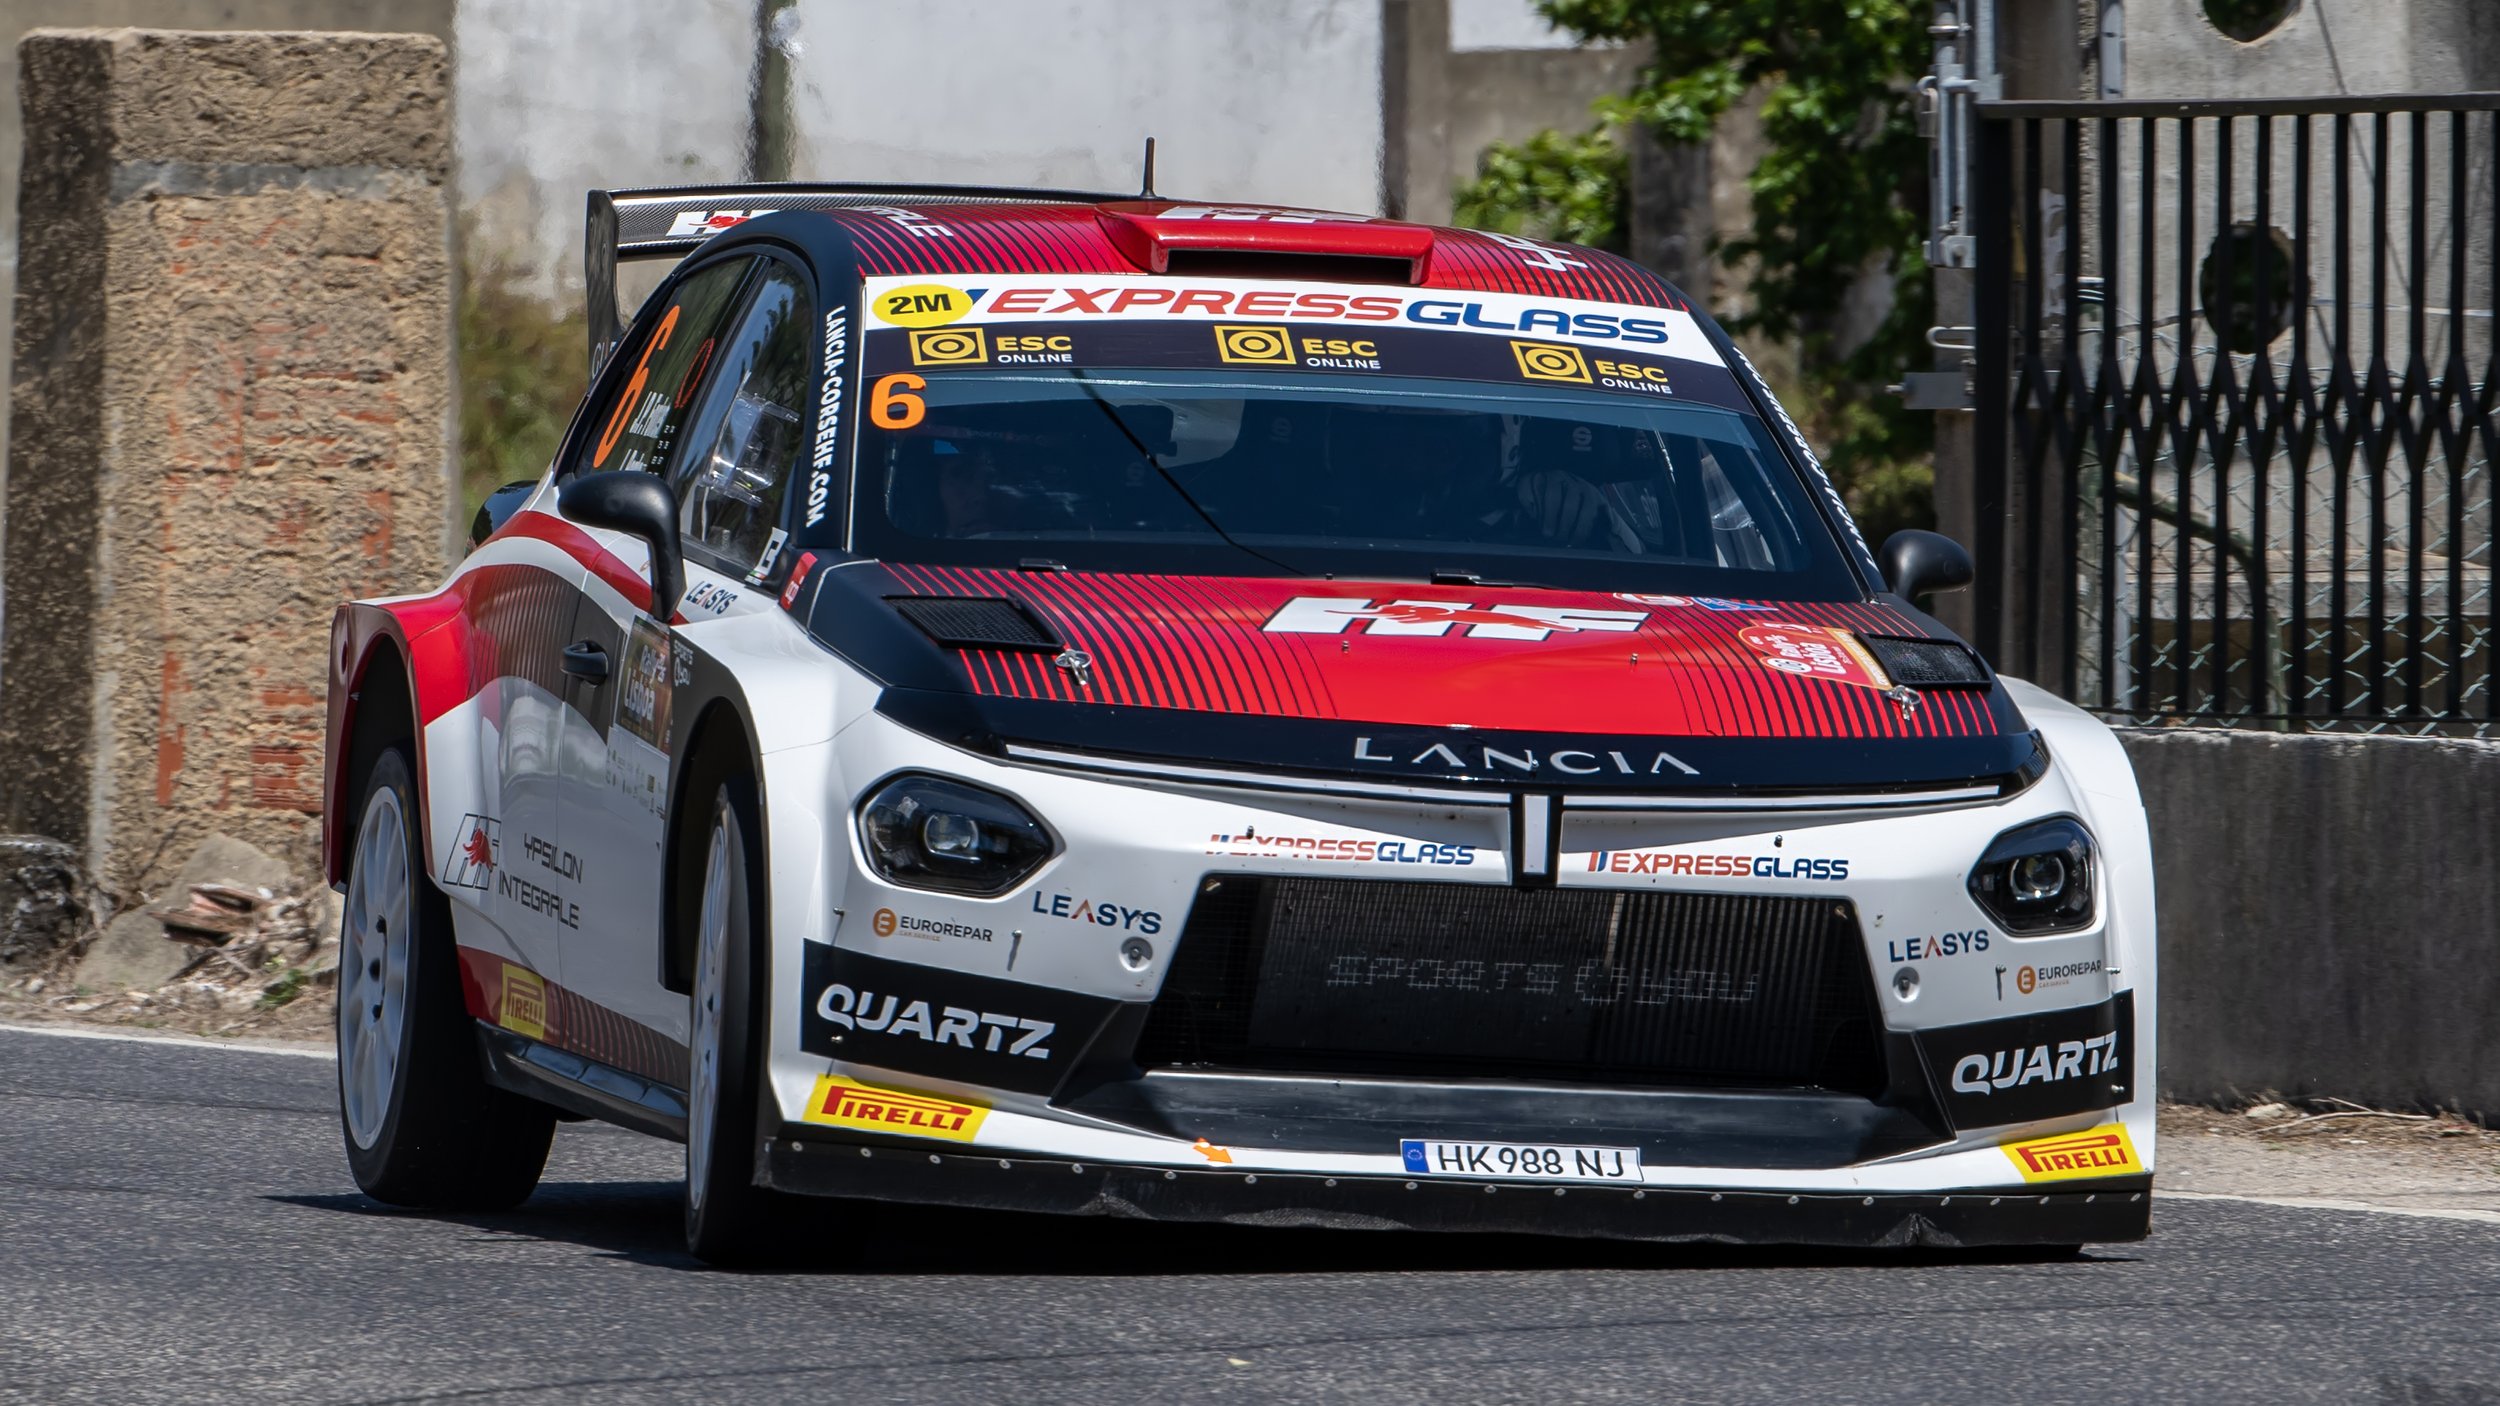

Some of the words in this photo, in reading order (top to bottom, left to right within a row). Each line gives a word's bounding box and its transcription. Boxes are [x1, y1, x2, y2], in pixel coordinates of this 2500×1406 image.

[888, 292, 953, 316] 2M
[986, 287, 1670, 345] EXPRESSGLASS
[995, 335, 1073, 353] ESC
[996, 352, 1073, 364] ONLINE
[1301, 337, 1379, 358] ESC
[1305, 356, 1382, 370] ONLINE
[593, 304, 681, 469] 6
[1594, 359, 1669, 383] ESC
[1601, 376, 1674, 395] ONLINE
[804, 304, 847, 529] LANCIA-CORSEHF.COM
[868, 372, 928, 430] 6
[685, 580, 739, 615] LEASYS
[624, 667, 656, 721] Lisboa
[1354, 736, 1701, 776] LANCIA
[523, 832, 585, 885] YPSILON
[1610, 851, 1849, 881] EXPRESSGLASS
[498, 870, 581, 930] INTEGRALE
[1032, 890, 1163, 935] LEASYS
[899, 915, 994, 942] EUROREPAR
[1888, 929, 1990, 964] LEASYS
[2038, 960, 2102, 981] EUROREPAR
[505, 976, 543, 1026] PIRELLI
[816, 982, 1056, 1060] QUARTZ
[1950, 1029, 2119, 1097] QUARTZ
[820, 1085, 974, 1132] PIRELLI
[1575, 1149, 1626, 1178] NJ
[2015, 1133, 2130, 1173] PIRELLI
